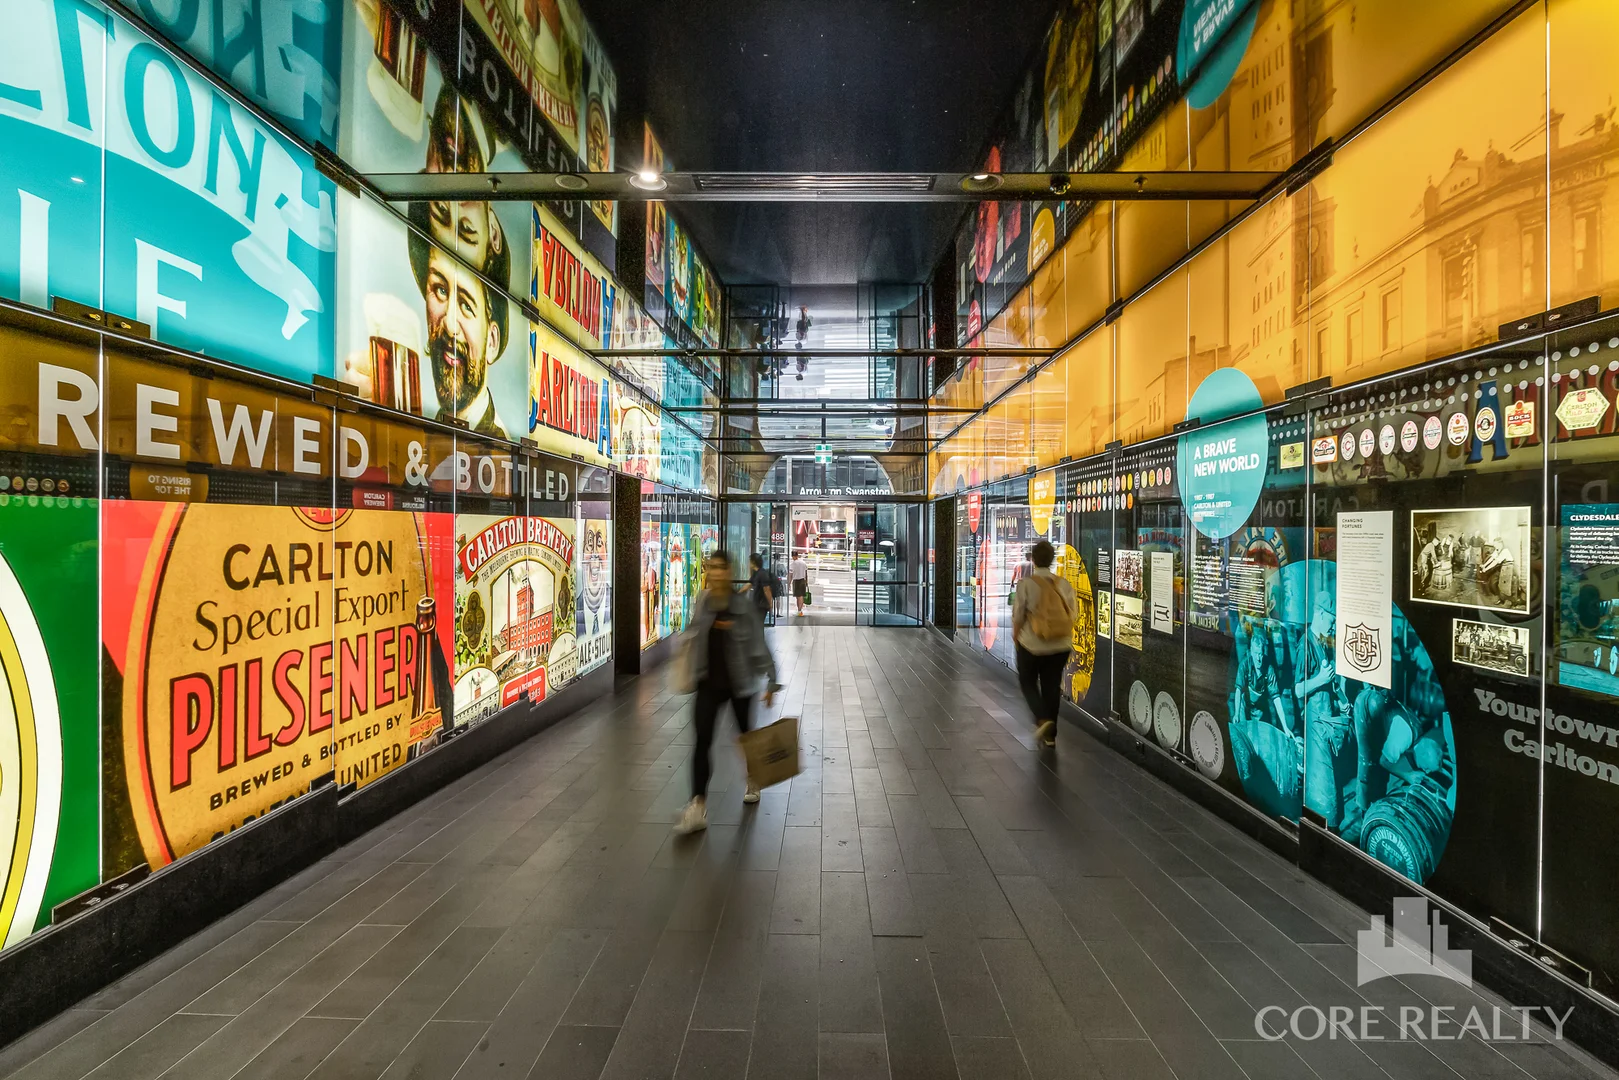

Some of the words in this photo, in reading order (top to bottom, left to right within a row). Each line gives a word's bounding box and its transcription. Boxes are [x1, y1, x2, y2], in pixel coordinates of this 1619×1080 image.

[38, 362, 370, 479] REWED
[405, 440, 429, 487] &
[455, 451, 570, 502] BOTTLED
[1194, 446, 1202, 461] A
[1204, 438, 1237, 457] BRAVE
[1194, 460, 1218, 478] NEW
[1219, 453, 1260, 474] WORLD
[223, 540, 393, 591] CARLTON
[466, 517, 524, 572] CARLTON
[528, 517, 573, 559] BREWERY
[193, 591, 320, 655] Special
[334, 579, 410, 626] Export
[170, 623, 418, 793] PILSENER
[1474, 688, 1541, 726] Your
[210, 760, 294, 811] BREWED
[301, 754, 312, 769] &
[320, 724, 380, 760] BOTTLED
[386, 713, 403, 731] BY
[340, 743, 401, 785] UNITED
[1503, 729, 1619, 786] Carlton
